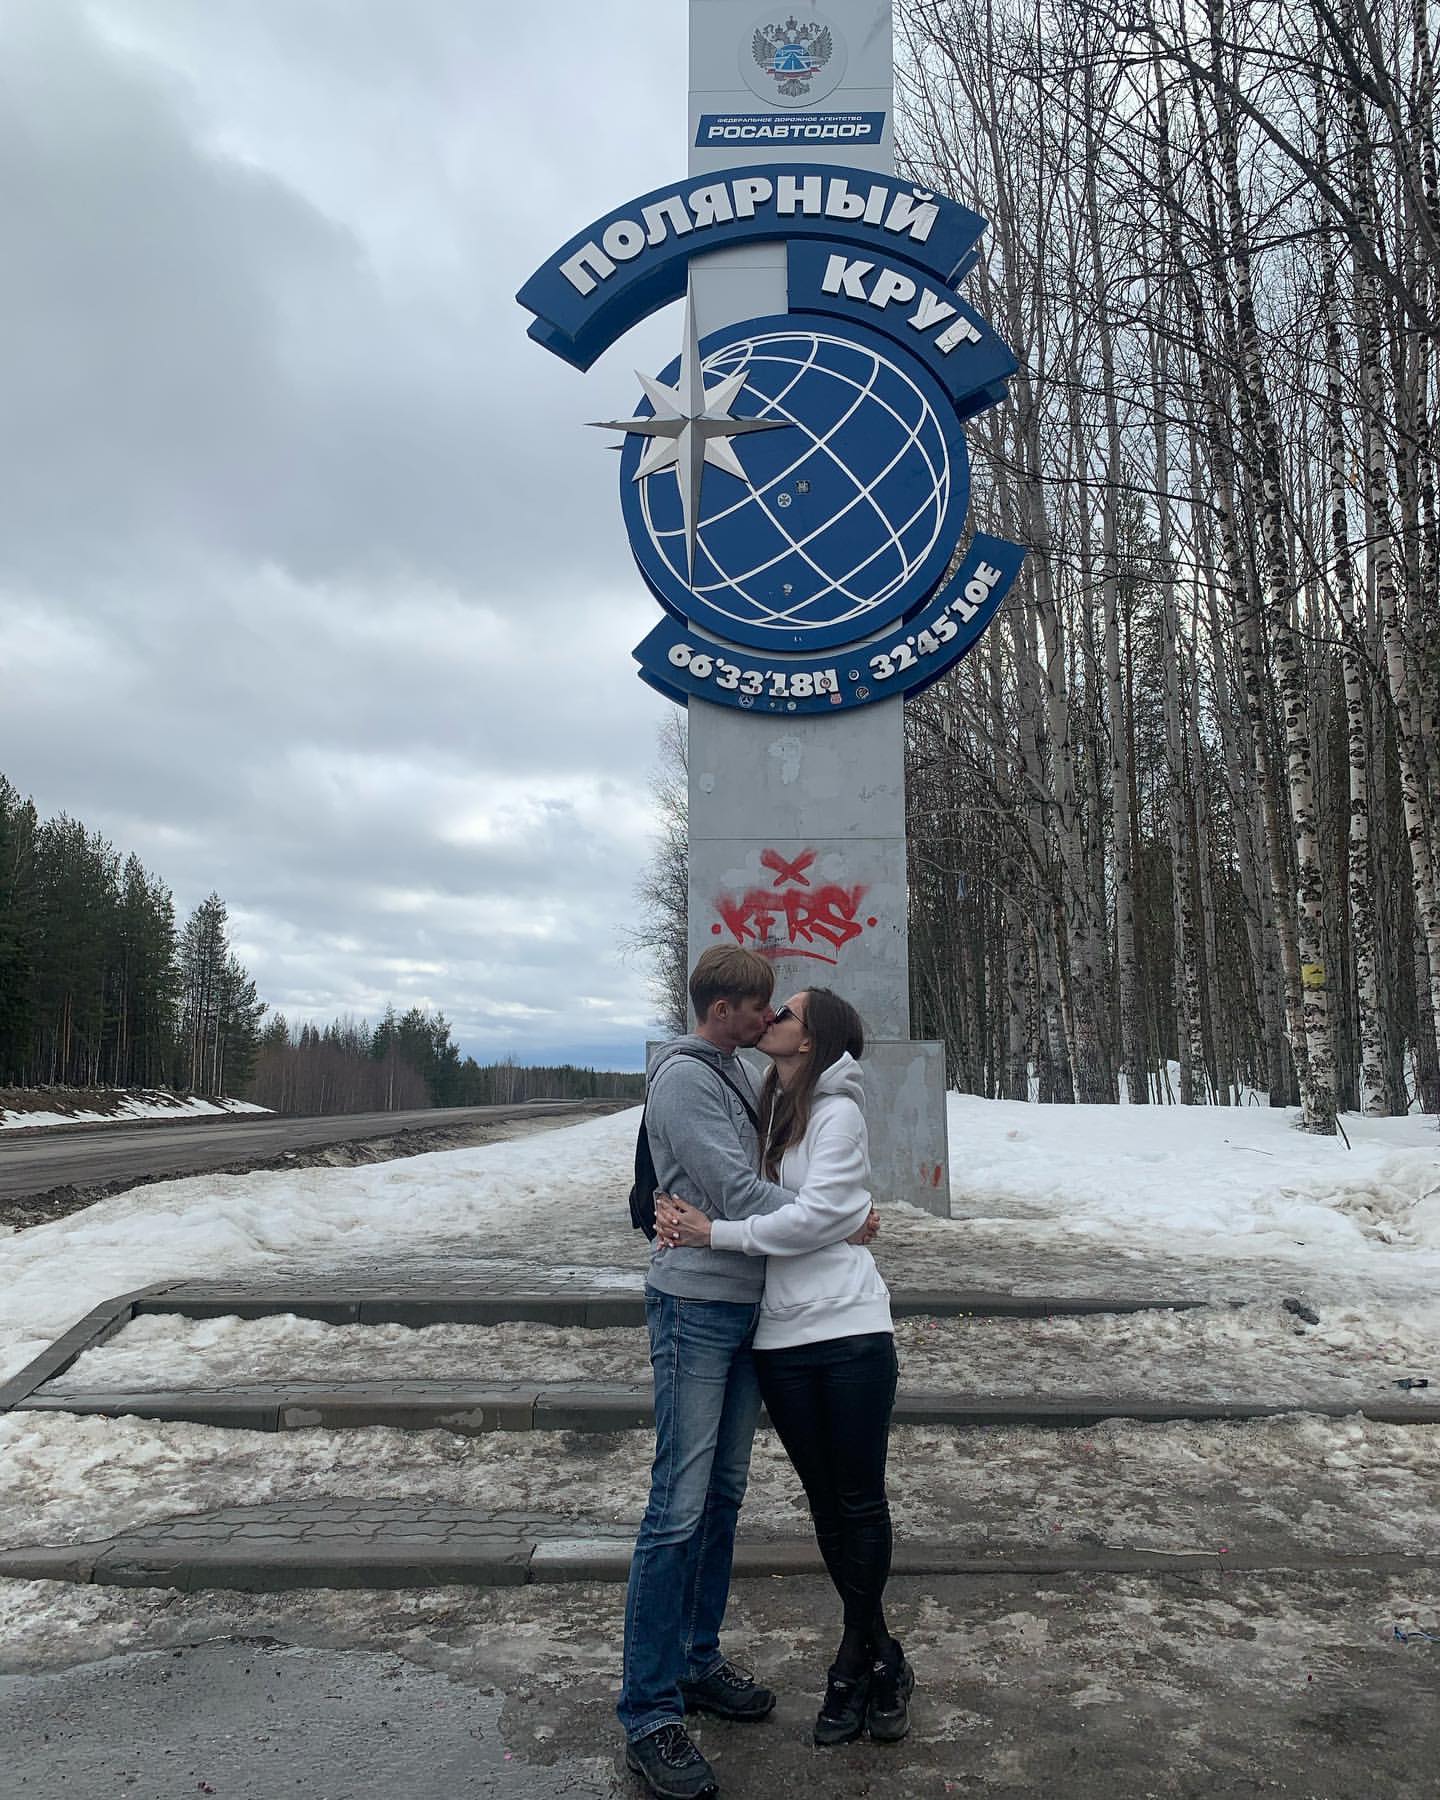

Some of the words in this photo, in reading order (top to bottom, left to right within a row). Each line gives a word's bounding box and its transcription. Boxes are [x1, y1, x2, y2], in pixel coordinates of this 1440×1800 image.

[707, 124, 872, 139] РОСАВТОДОР
[559, 175, 940, 296] ПОЛЯРНЫЙ
[821, 254, 983, 355] КРУГ
